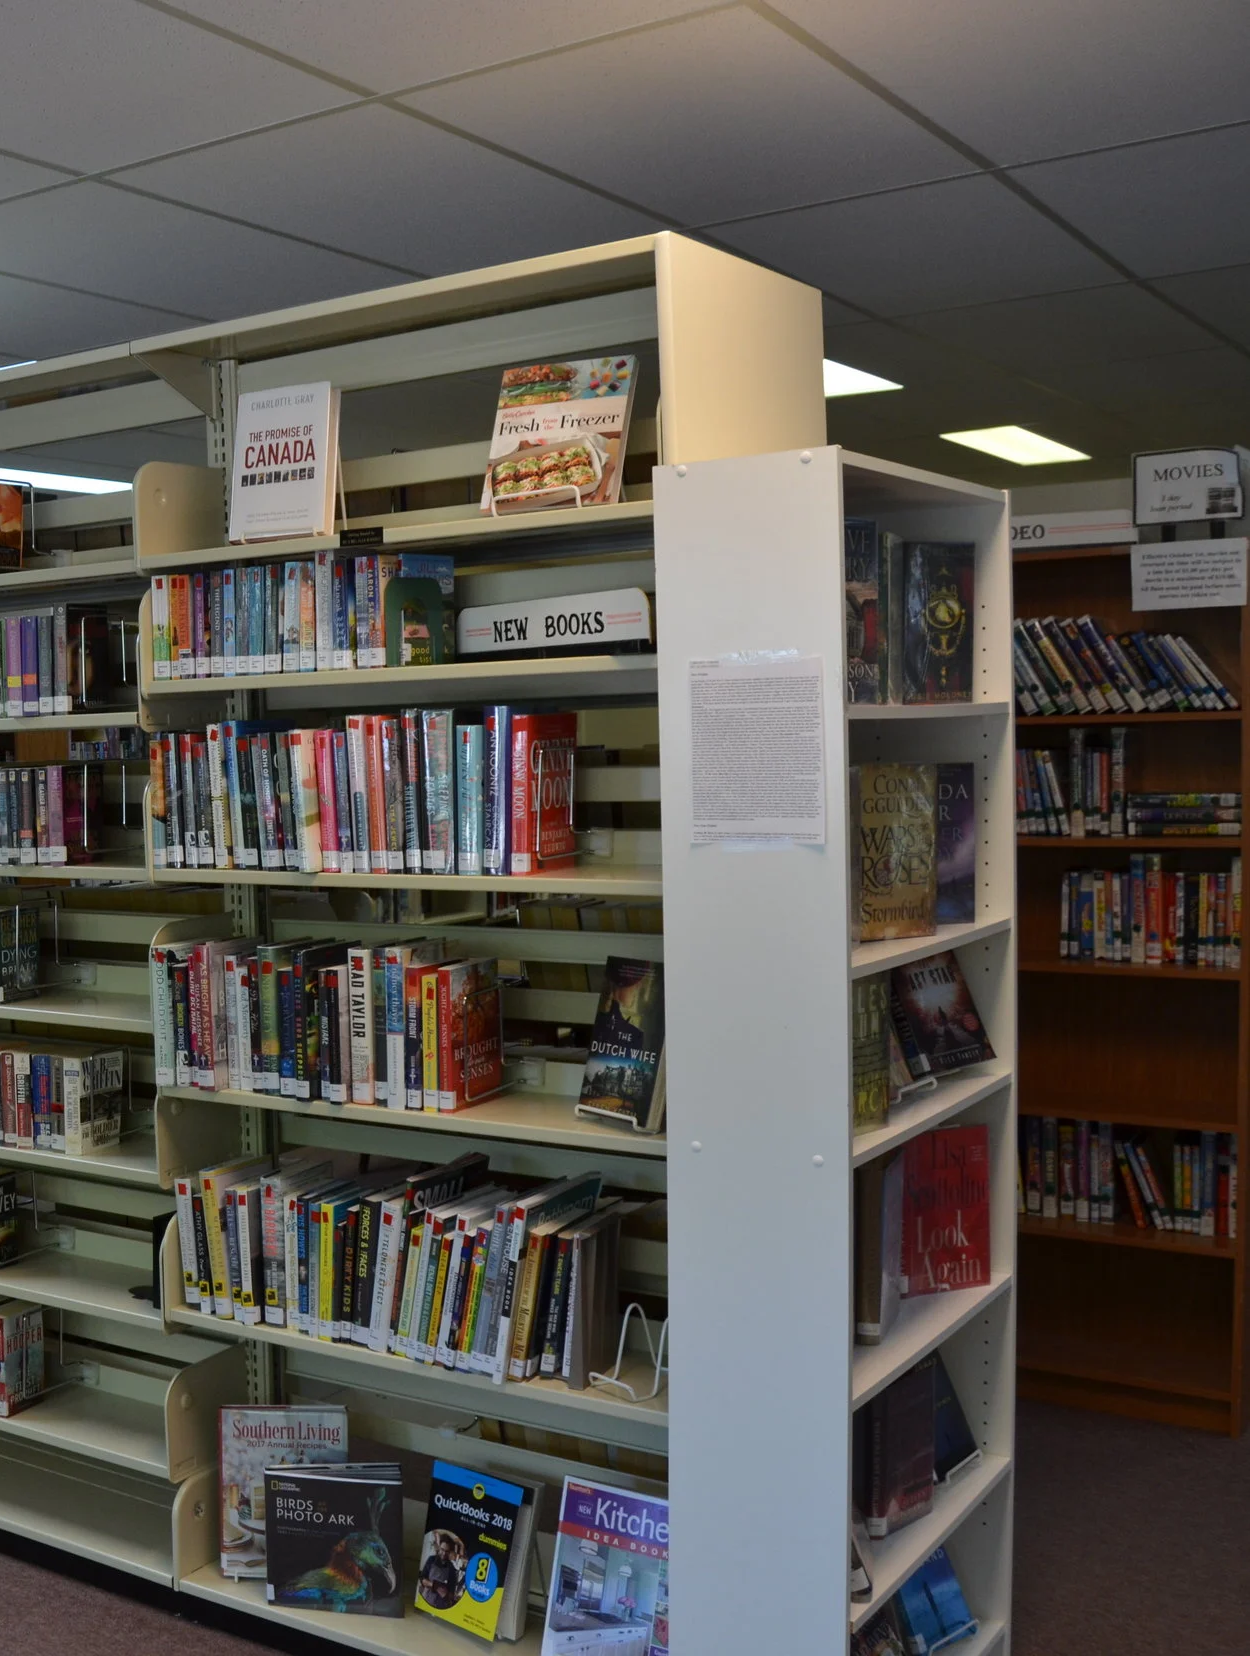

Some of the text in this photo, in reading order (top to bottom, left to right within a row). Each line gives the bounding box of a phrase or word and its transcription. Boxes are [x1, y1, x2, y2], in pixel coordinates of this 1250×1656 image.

[250, 393, 315, 411] CHARLOTTE GRAY
[249, 424, 314, 443] THE PROMISE OF
[498, 417, 540, 436] Fresh
[560, 413, 620, 429] Freezer
[244, 438, 316, 469] CANADA
[1153, 464, 1224, 482] MOVIES
[213, 588, 222, 632] THE LEGEND
[368, 602, 376, 626] SALA
[493, 611, 605, 643] NEW BOOKS
[261, 748, 270, 767] OATH
[262, 769, 270, 778] OF
[489, 749, 499, 797] KOONTZ
[38, 783, 47, 826] HEATHER GRAHAM
[438, 774, 450, 817] SLEEPING
[513, 786, 526, 820] MOON
[200, 962, 208, 976] AS
[928, 965, 956, 986] STAR
[154, 963, 166, 1041] ODD CHILD OUT
[201, 979, 210, 1012] BRIGHT
[389, 967, 402, 1027] nancy thayer
[203, 1015, 210, 1029] AS
[351, 993, 366, 1039] TAYLOR
[409, 996, 417, 1039] STORM FRONT
[177, 1028, 185, 1049] BONES
[441, 1024, 449, 1048] SENSES
[618, 1031, 632, 1043] THE
[591, 1041, 657, 1064] DUTCH WIFE
[16, 1074, 26, 1104] GRIFFIN
[195, 1205, 204, 1256] ATHY GLASS
[264, 1209, 278, 1257] BARRIERS
[359, 1209, 371, 1240] FORCES
[916, 1208, 969, 1253] Look
[298, 1230, 307, 1259] HOWES
[500, 1241, 513, 1274] HOUSE
[342, 1246, 354, 1313] DIRTY KIDS
[358, 1254, 368, 1278] FACES
[376, 1239, 390, 1306] TELOMERE EFFECT
[426, 1264, 435, 1281] RENAL
[436, 1250, 449, 1296] MEAL PREP
[923, 1247, 983, 1291] Again
[425, 1282, 433, 1297] DIET
[503, 1267, 514, 1310] IDEA BOOK
[516, 1306, 530, 1341] MOUNTAIN
[232, 1419, 341, 1445] Southern Living
[246, 1440, 327, 1450] 2017 Annual Recipes
[276, 1497, 314, 1511] BIRDS
[276, 1509, 355, 1526] PHOTO ARK
[434, 1494, 513, 1531] QuickBooks 2018
[578, 1497, 668, 1543] NEW Kitche
[478, 1532, 507, 1551] dummies
[585, 1530, 668, 1559] IDEA BOOK
[475, 1558, 489, 1581] 8
[469, 1579, 491, 1596] Books
